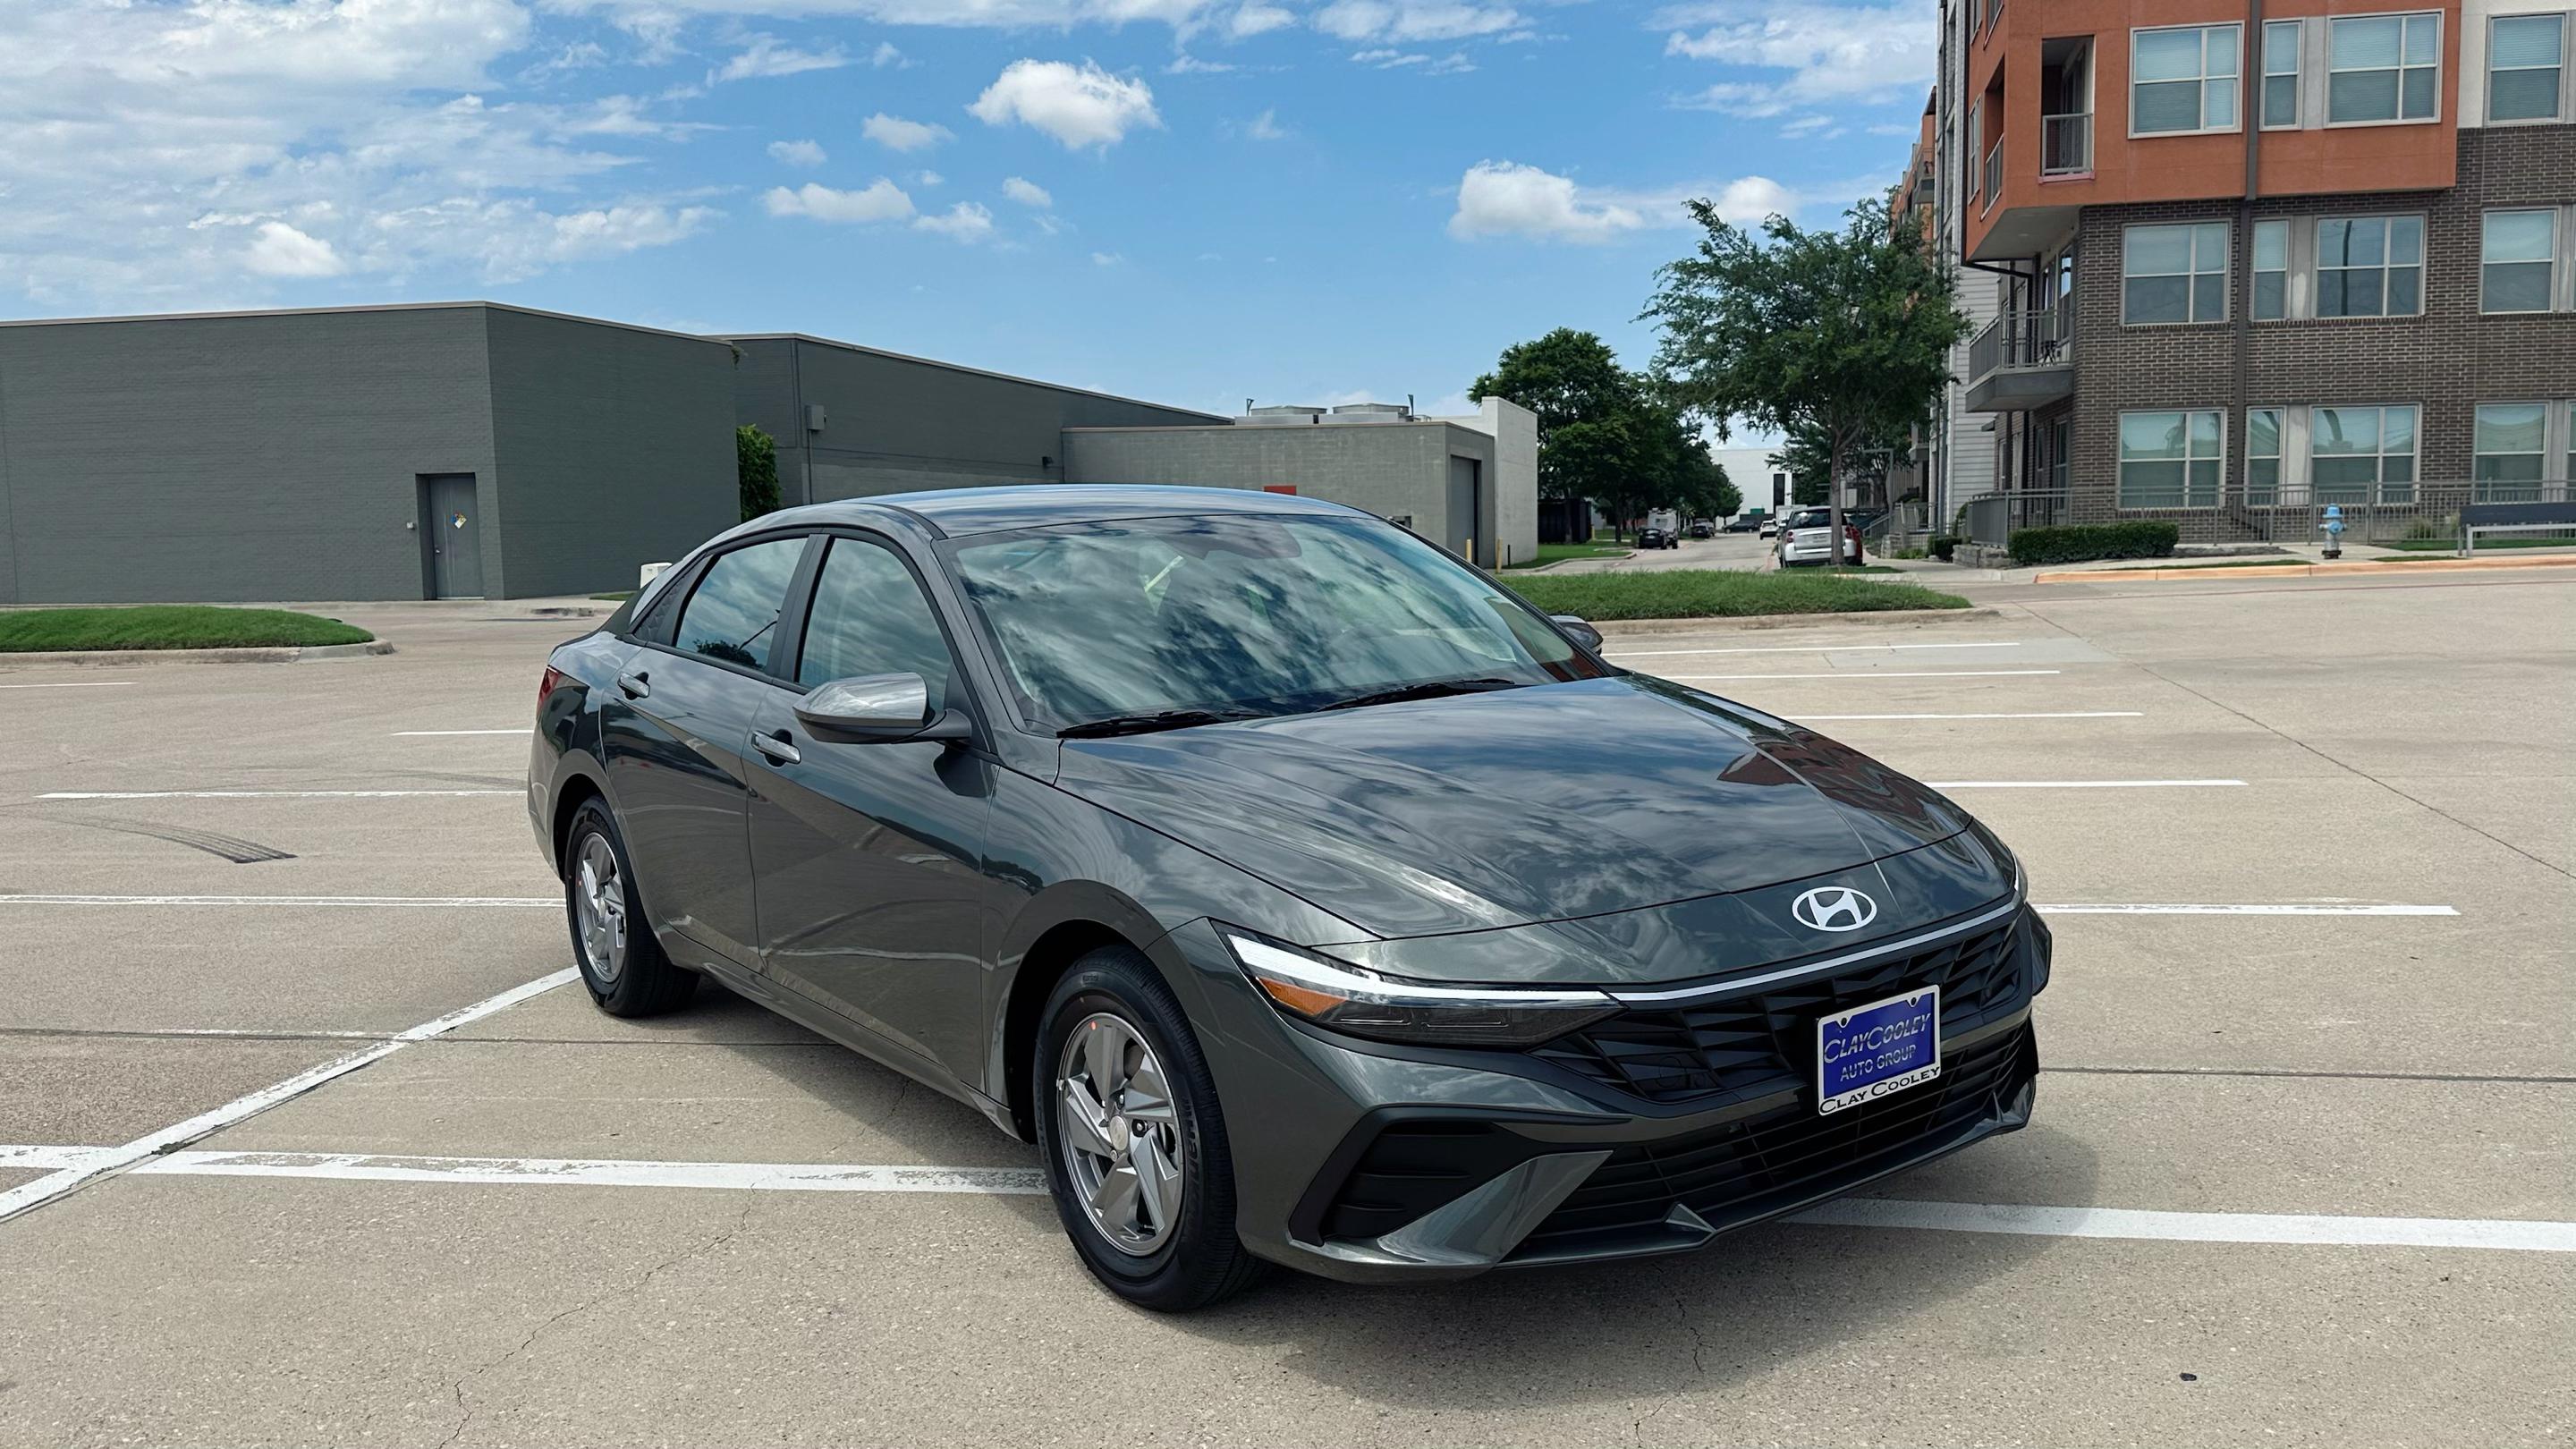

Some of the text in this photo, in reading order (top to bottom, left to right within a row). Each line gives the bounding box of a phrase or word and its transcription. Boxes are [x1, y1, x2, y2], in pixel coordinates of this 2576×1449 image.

[1840, 1045, 1917, 1081] AUTO GROUP
[1819, 1066, 1940, 1114] CLAY COOLEY
